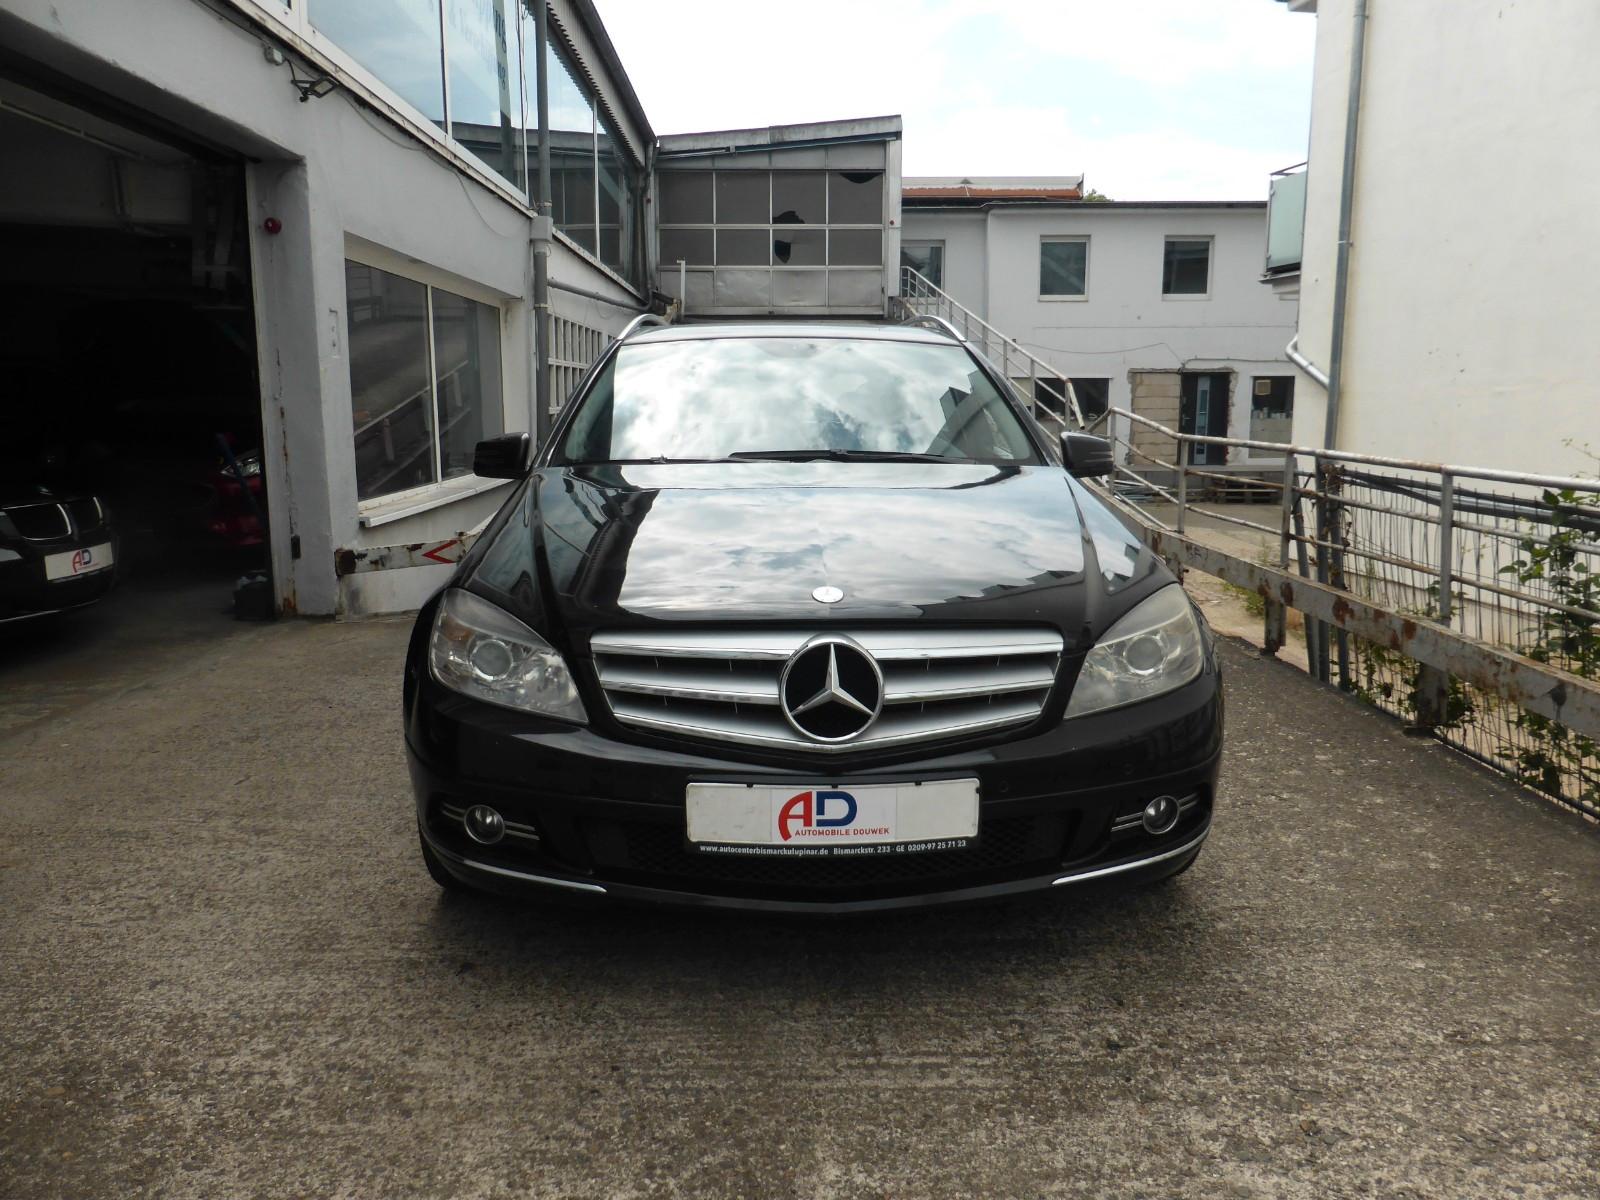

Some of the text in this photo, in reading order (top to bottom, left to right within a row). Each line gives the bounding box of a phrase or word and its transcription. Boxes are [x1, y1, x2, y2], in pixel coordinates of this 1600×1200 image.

[778, 790, 858, 841] AD
[794, 827, 890, 837] AUTOMOBILE DOUWEK
[833, 846, 876, 855] Bismarckstr.
[877, 845, 891, 854] 233
[896, 844, 905, 853] GE
[908, 843, 936, 852] 0209-97
[937, 841, 946, 849] 25
[947, 840, 956, 848] 71
[957, 839, 967, 847] 23
